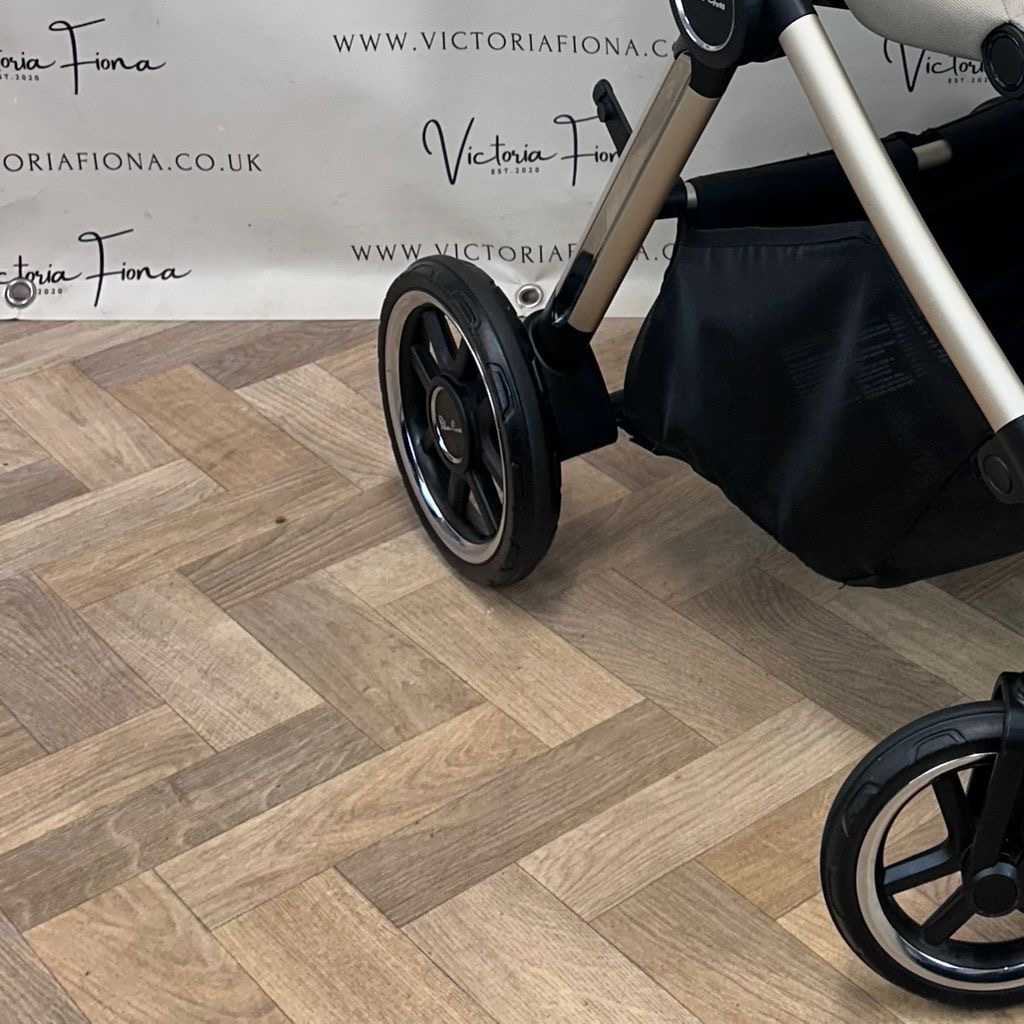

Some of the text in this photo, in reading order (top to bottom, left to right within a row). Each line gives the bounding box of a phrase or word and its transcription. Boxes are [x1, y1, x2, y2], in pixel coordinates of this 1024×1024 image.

[0, 18, 167, 96] oria Fiona
[3, 153, 261, 172] ORIAFIONA.CO.UK
[421, 116, 558, 187] Victoria
[490, 166, 540, 176] EST.2020
[77, 228, 192, 310] Fiona
